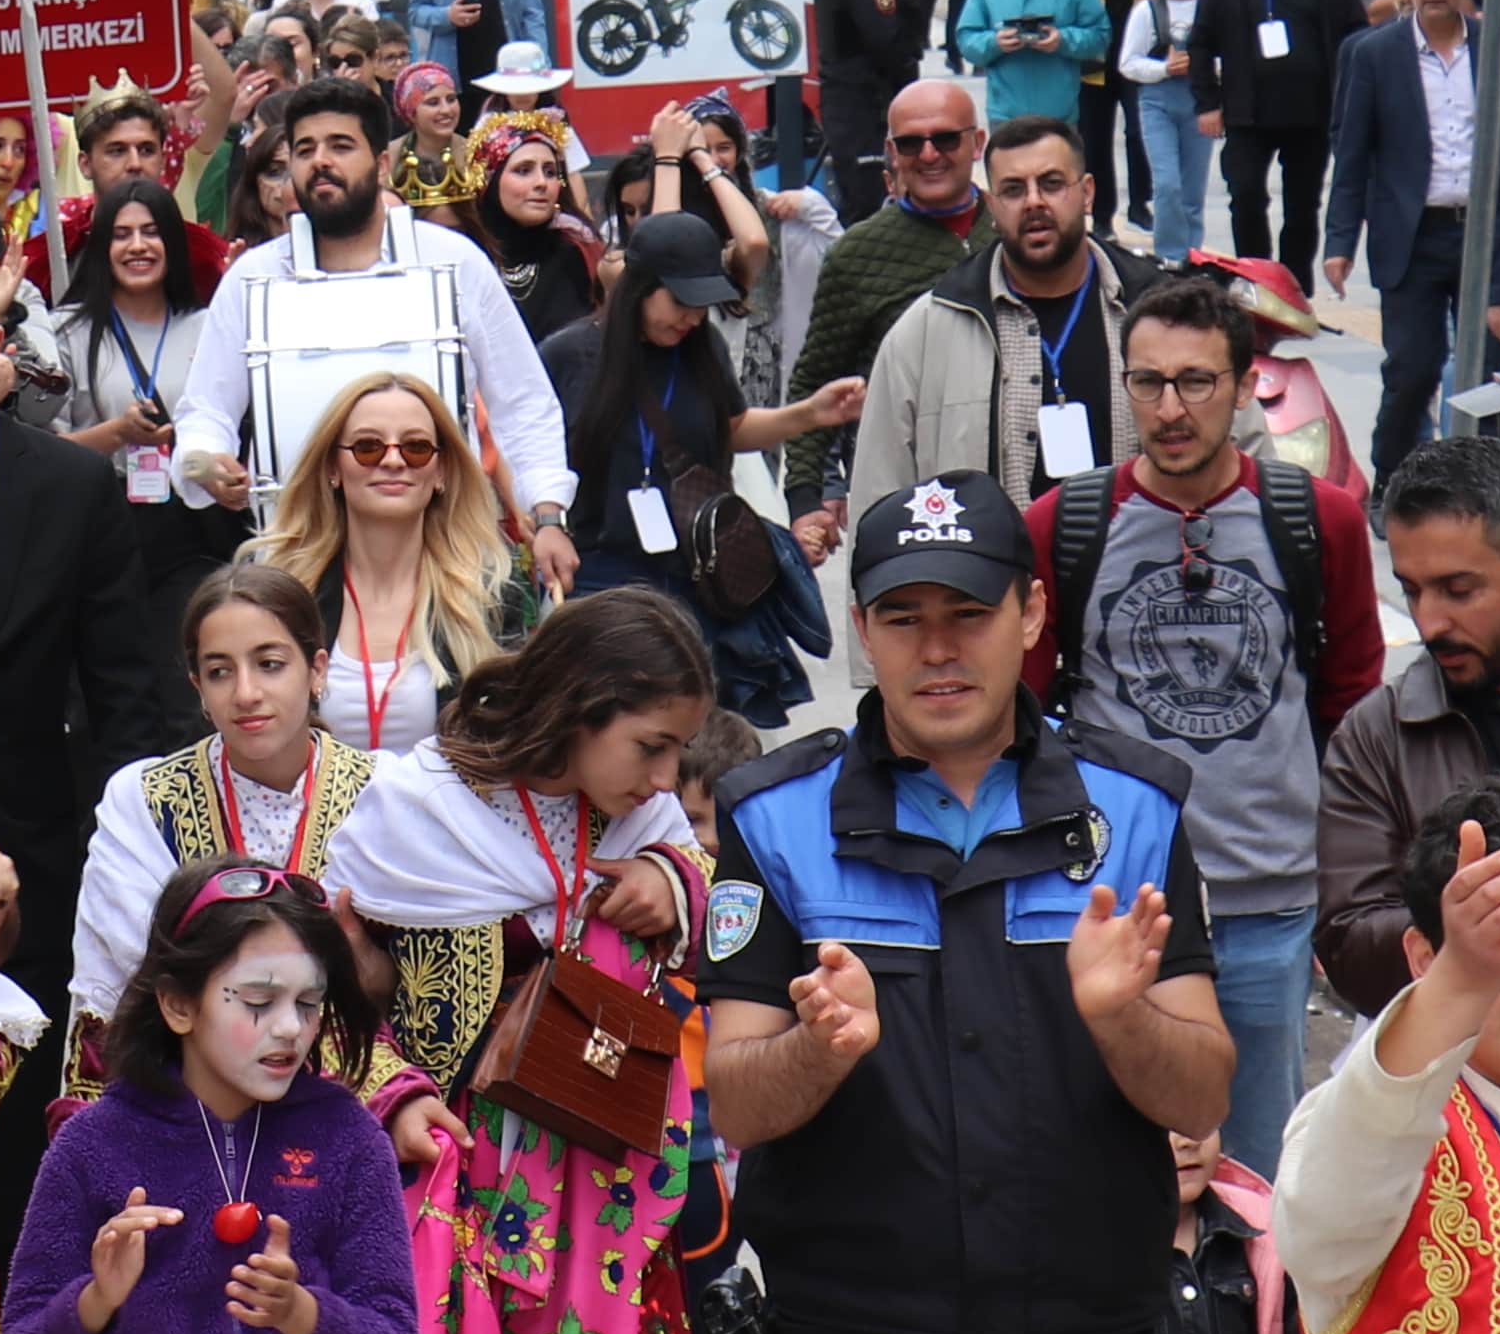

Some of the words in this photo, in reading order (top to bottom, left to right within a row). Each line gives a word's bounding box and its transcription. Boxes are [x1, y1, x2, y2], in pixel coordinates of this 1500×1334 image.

[37, 12, 144, 51] MERKEZİ
[898, 526, 973, 545] POLİS
[1155, 605, 1241, 624] CHAMPION
